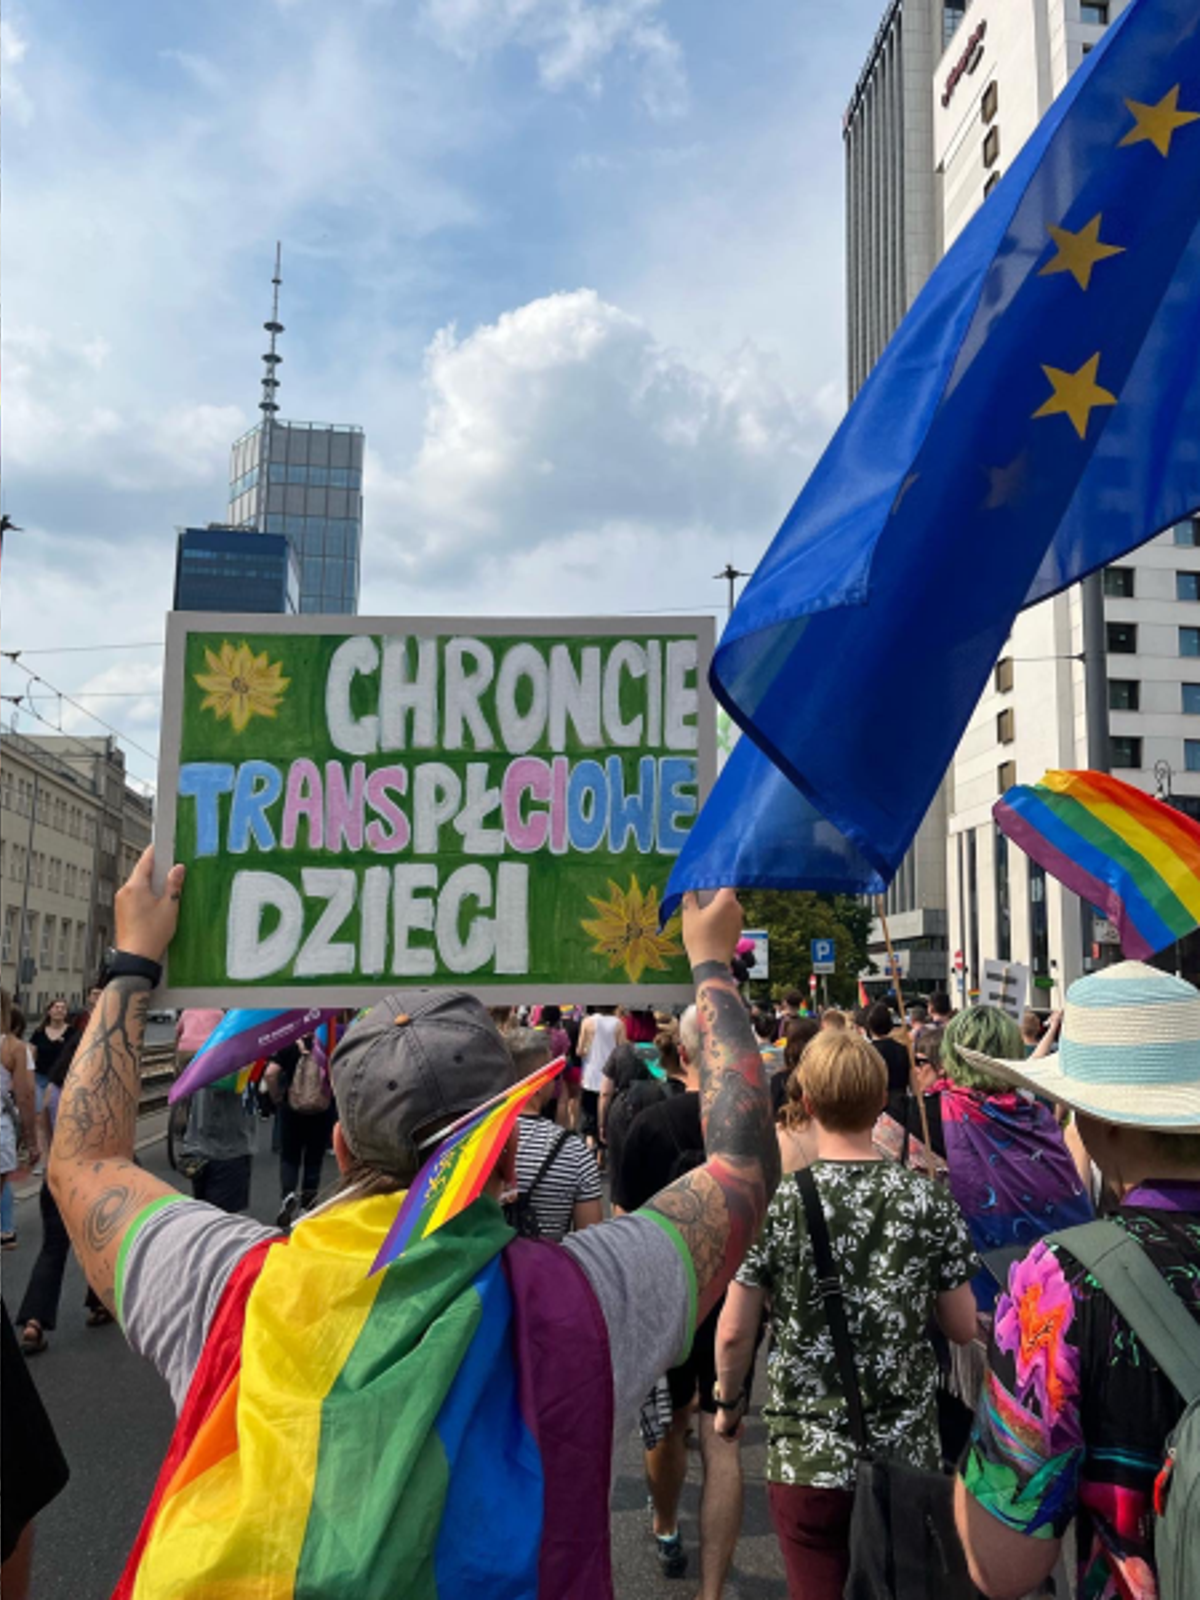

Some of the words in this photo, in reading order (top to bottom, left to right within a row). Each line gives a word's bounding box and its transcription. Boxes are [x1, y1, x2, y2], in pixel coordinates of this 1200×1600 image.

[325, 635, 698, 754] CHRONCIE
[179, 755, 698, 858] TRANSPŁCIOWE
[226, 862, 529, 979] DZIECI
[816, 941, 830, 960] P
